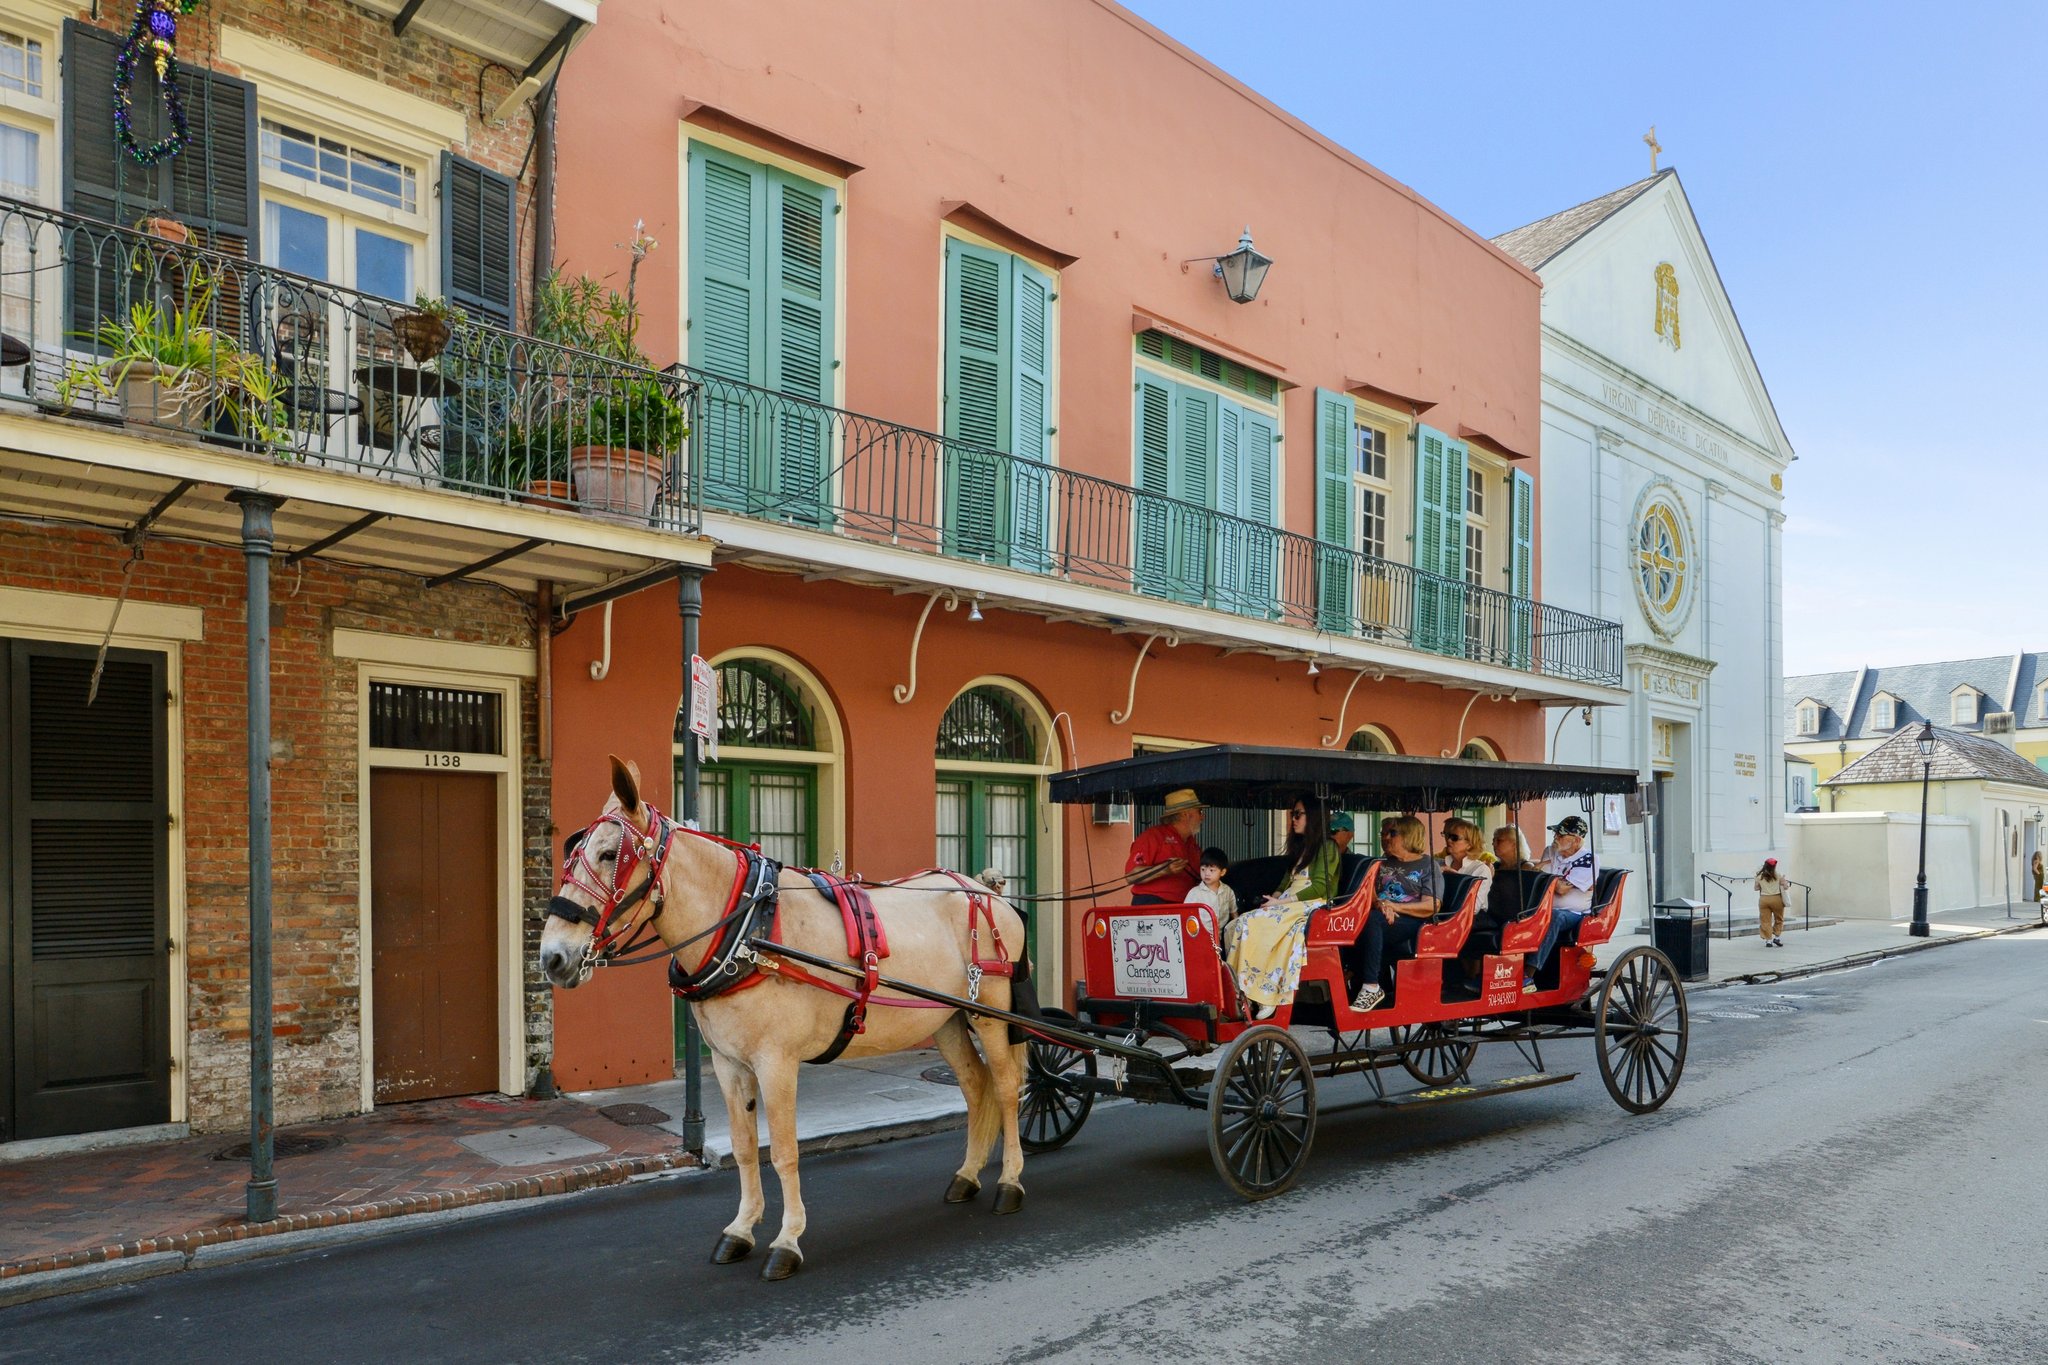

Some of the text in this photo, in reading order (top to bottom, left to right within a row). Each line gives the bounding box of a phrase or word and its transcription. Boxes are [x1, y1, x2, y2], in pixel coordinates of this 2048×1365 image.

[1602, 383, 1729, 464] VIRGINI DEIPARAE DICATUM
[425, 754, 460, 767] 1138
[1124, 936, 1170, 966] Royal
[1126, 964, 1171, 983] Carriages
